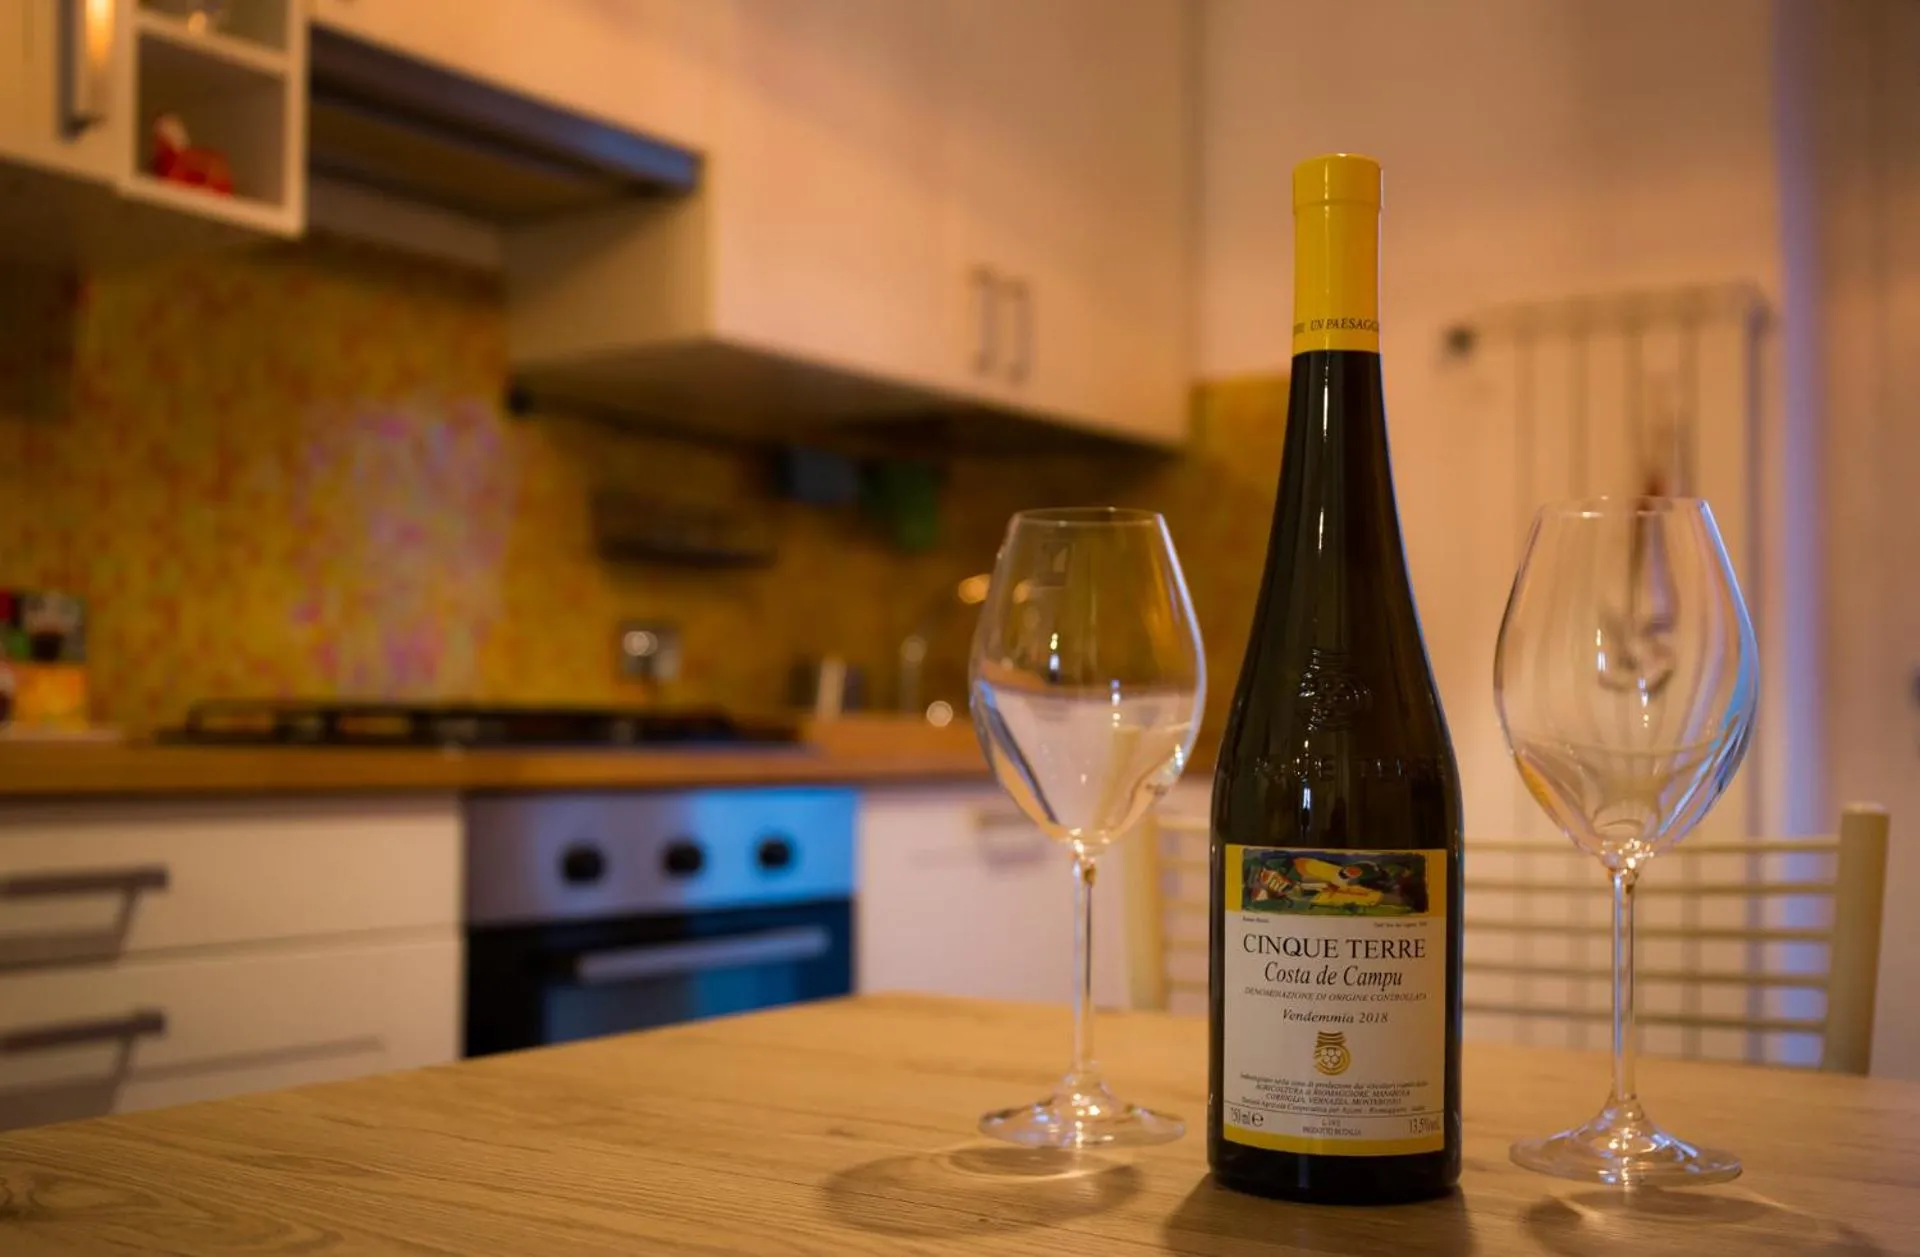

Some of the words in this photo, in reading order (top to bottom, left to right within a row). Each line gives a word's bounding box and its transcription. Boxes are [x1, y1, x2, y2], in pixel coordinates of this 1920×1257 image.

[1243, 933, 1339, 958] CINQUE
[1345, 938, 1426, 959] TERRE
[1265, 961, 1310, 984] Costa
[1316, 964, 1337, 986] de
[1343, 965, 1403, 992] Campu
[1328, 992, 1368, 1001] ORIGINE
[1282, 1008, 1355, 1024] Vendemmia
[1358, 1011, 1388, 1024] 2018
